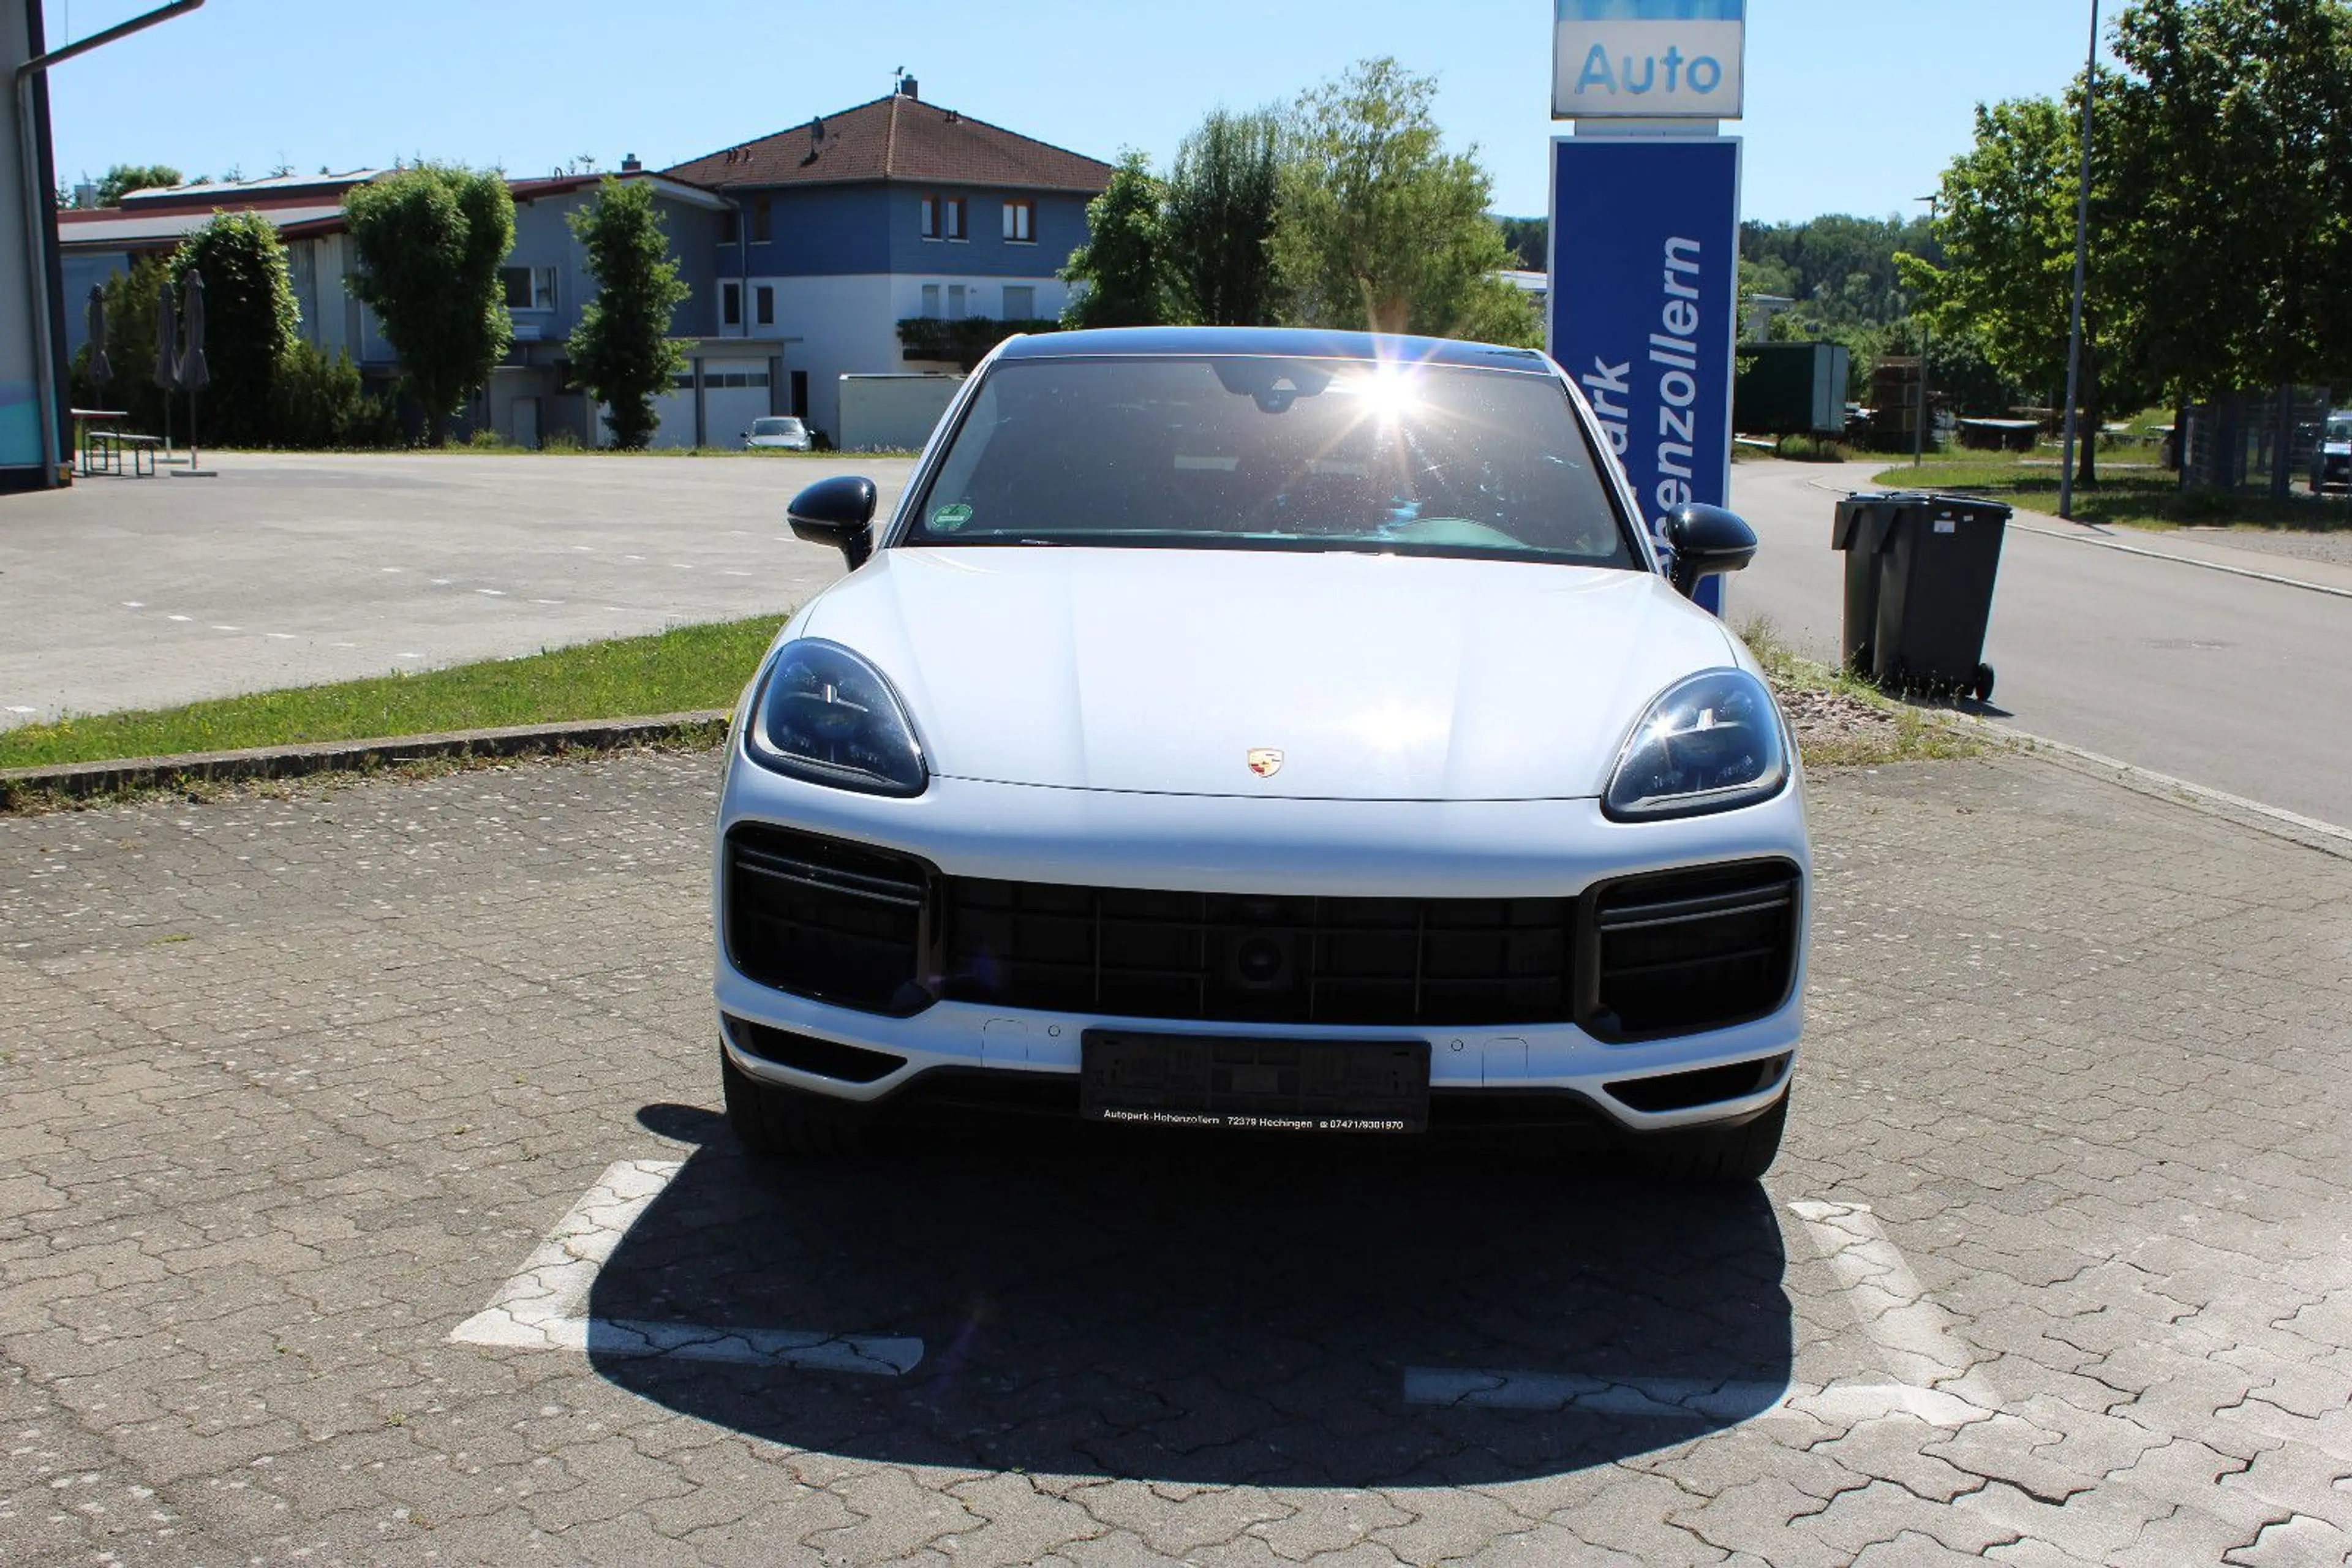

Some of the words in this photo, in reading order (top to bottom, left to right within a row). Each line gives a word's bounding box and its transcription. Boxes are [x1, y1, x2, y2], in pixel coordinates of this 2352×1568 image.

[1574, 43, 1722, 95] Auto
[1582, 355, 1636, 496] ark
[1259, 1118, 1312, 1129] Hechingen
